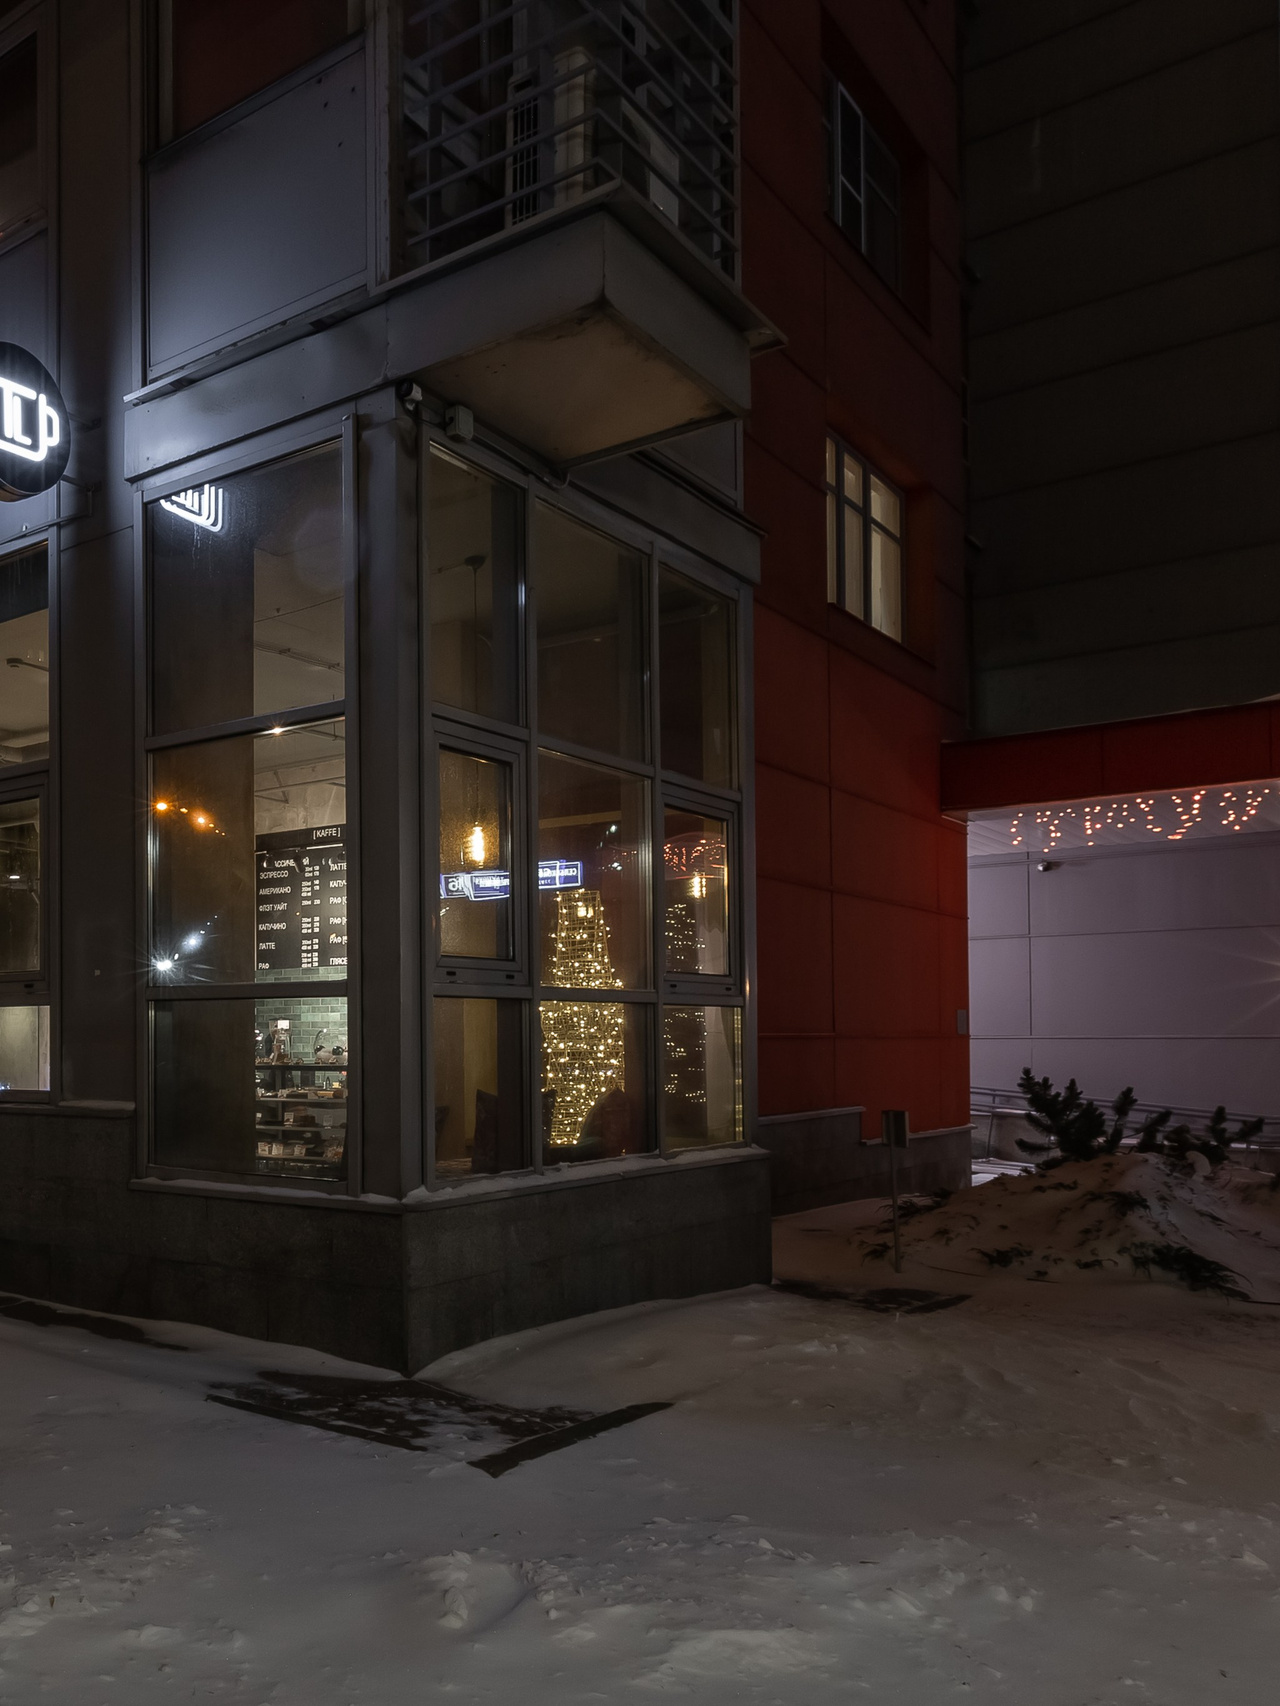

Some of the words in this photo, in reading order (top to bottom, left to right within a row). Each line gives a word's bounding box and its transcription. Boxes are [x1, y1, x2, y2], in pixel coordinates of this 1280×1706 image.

[259, 870, 289, 880] ЭСПРЕССО
[259, 886, 291, 895] АМЕРИКАНО
[330, 897, 341, 905] РАФ
[273, 902, 288, 911] УАЙТ
[330, 917, 341, 925] РАФ
[258, 922, 287, 931] КАПУЧИНО
[259, 942, 276, 950] ЛАТТЕ
